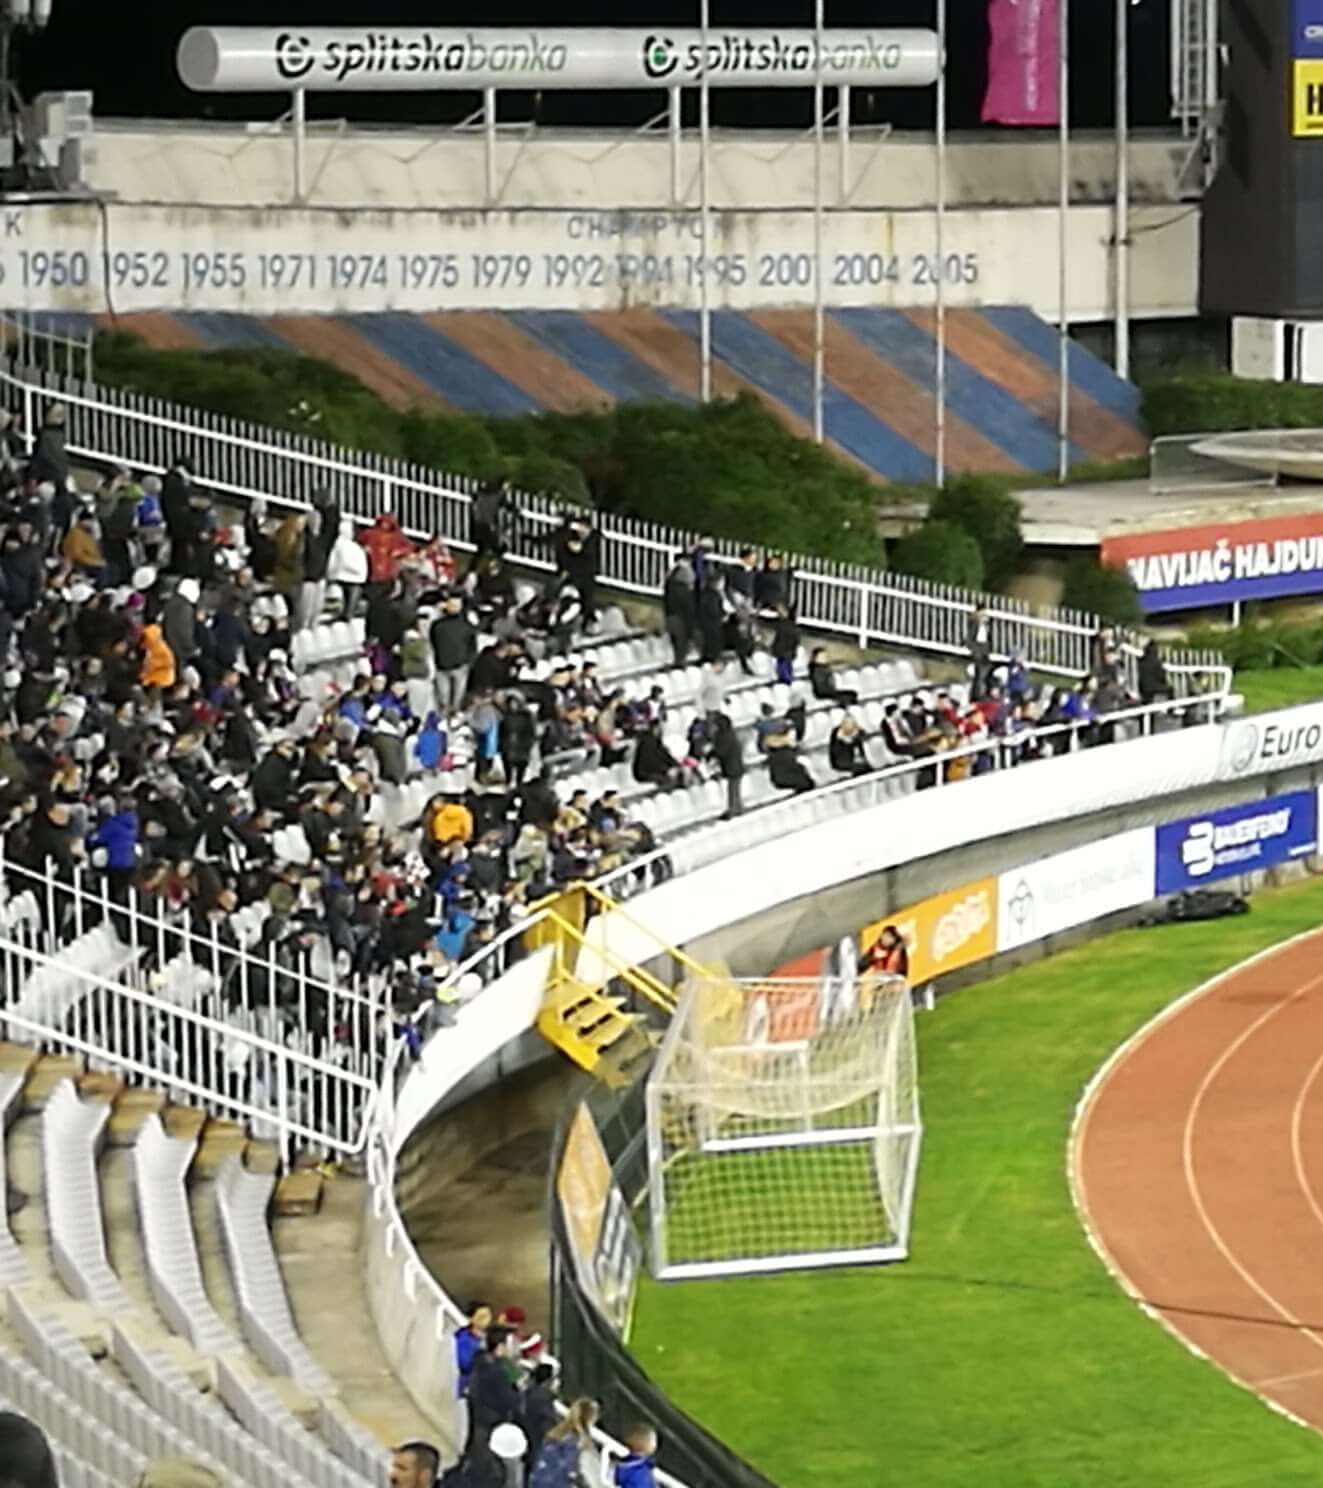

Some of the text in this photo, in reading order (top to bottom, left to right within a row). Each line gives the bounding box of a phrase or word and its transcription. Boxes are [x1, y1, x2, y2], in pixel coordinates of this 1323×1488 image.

[19, 250, 88, 288] 1950
[181, 250, 246, 290] 1955
[257, 253, 317, 289] 1971
[328, 254, 388, 289] 1974
[400, 254, 460, 289] 1975
[472, 254, 532, 289] 1979
[543, 254, 606, 288] 1992
[759, 254, 818, 287] 200
[833, 253, 900, 287] 2004
[1260, 723, 1321, 760] Euro
